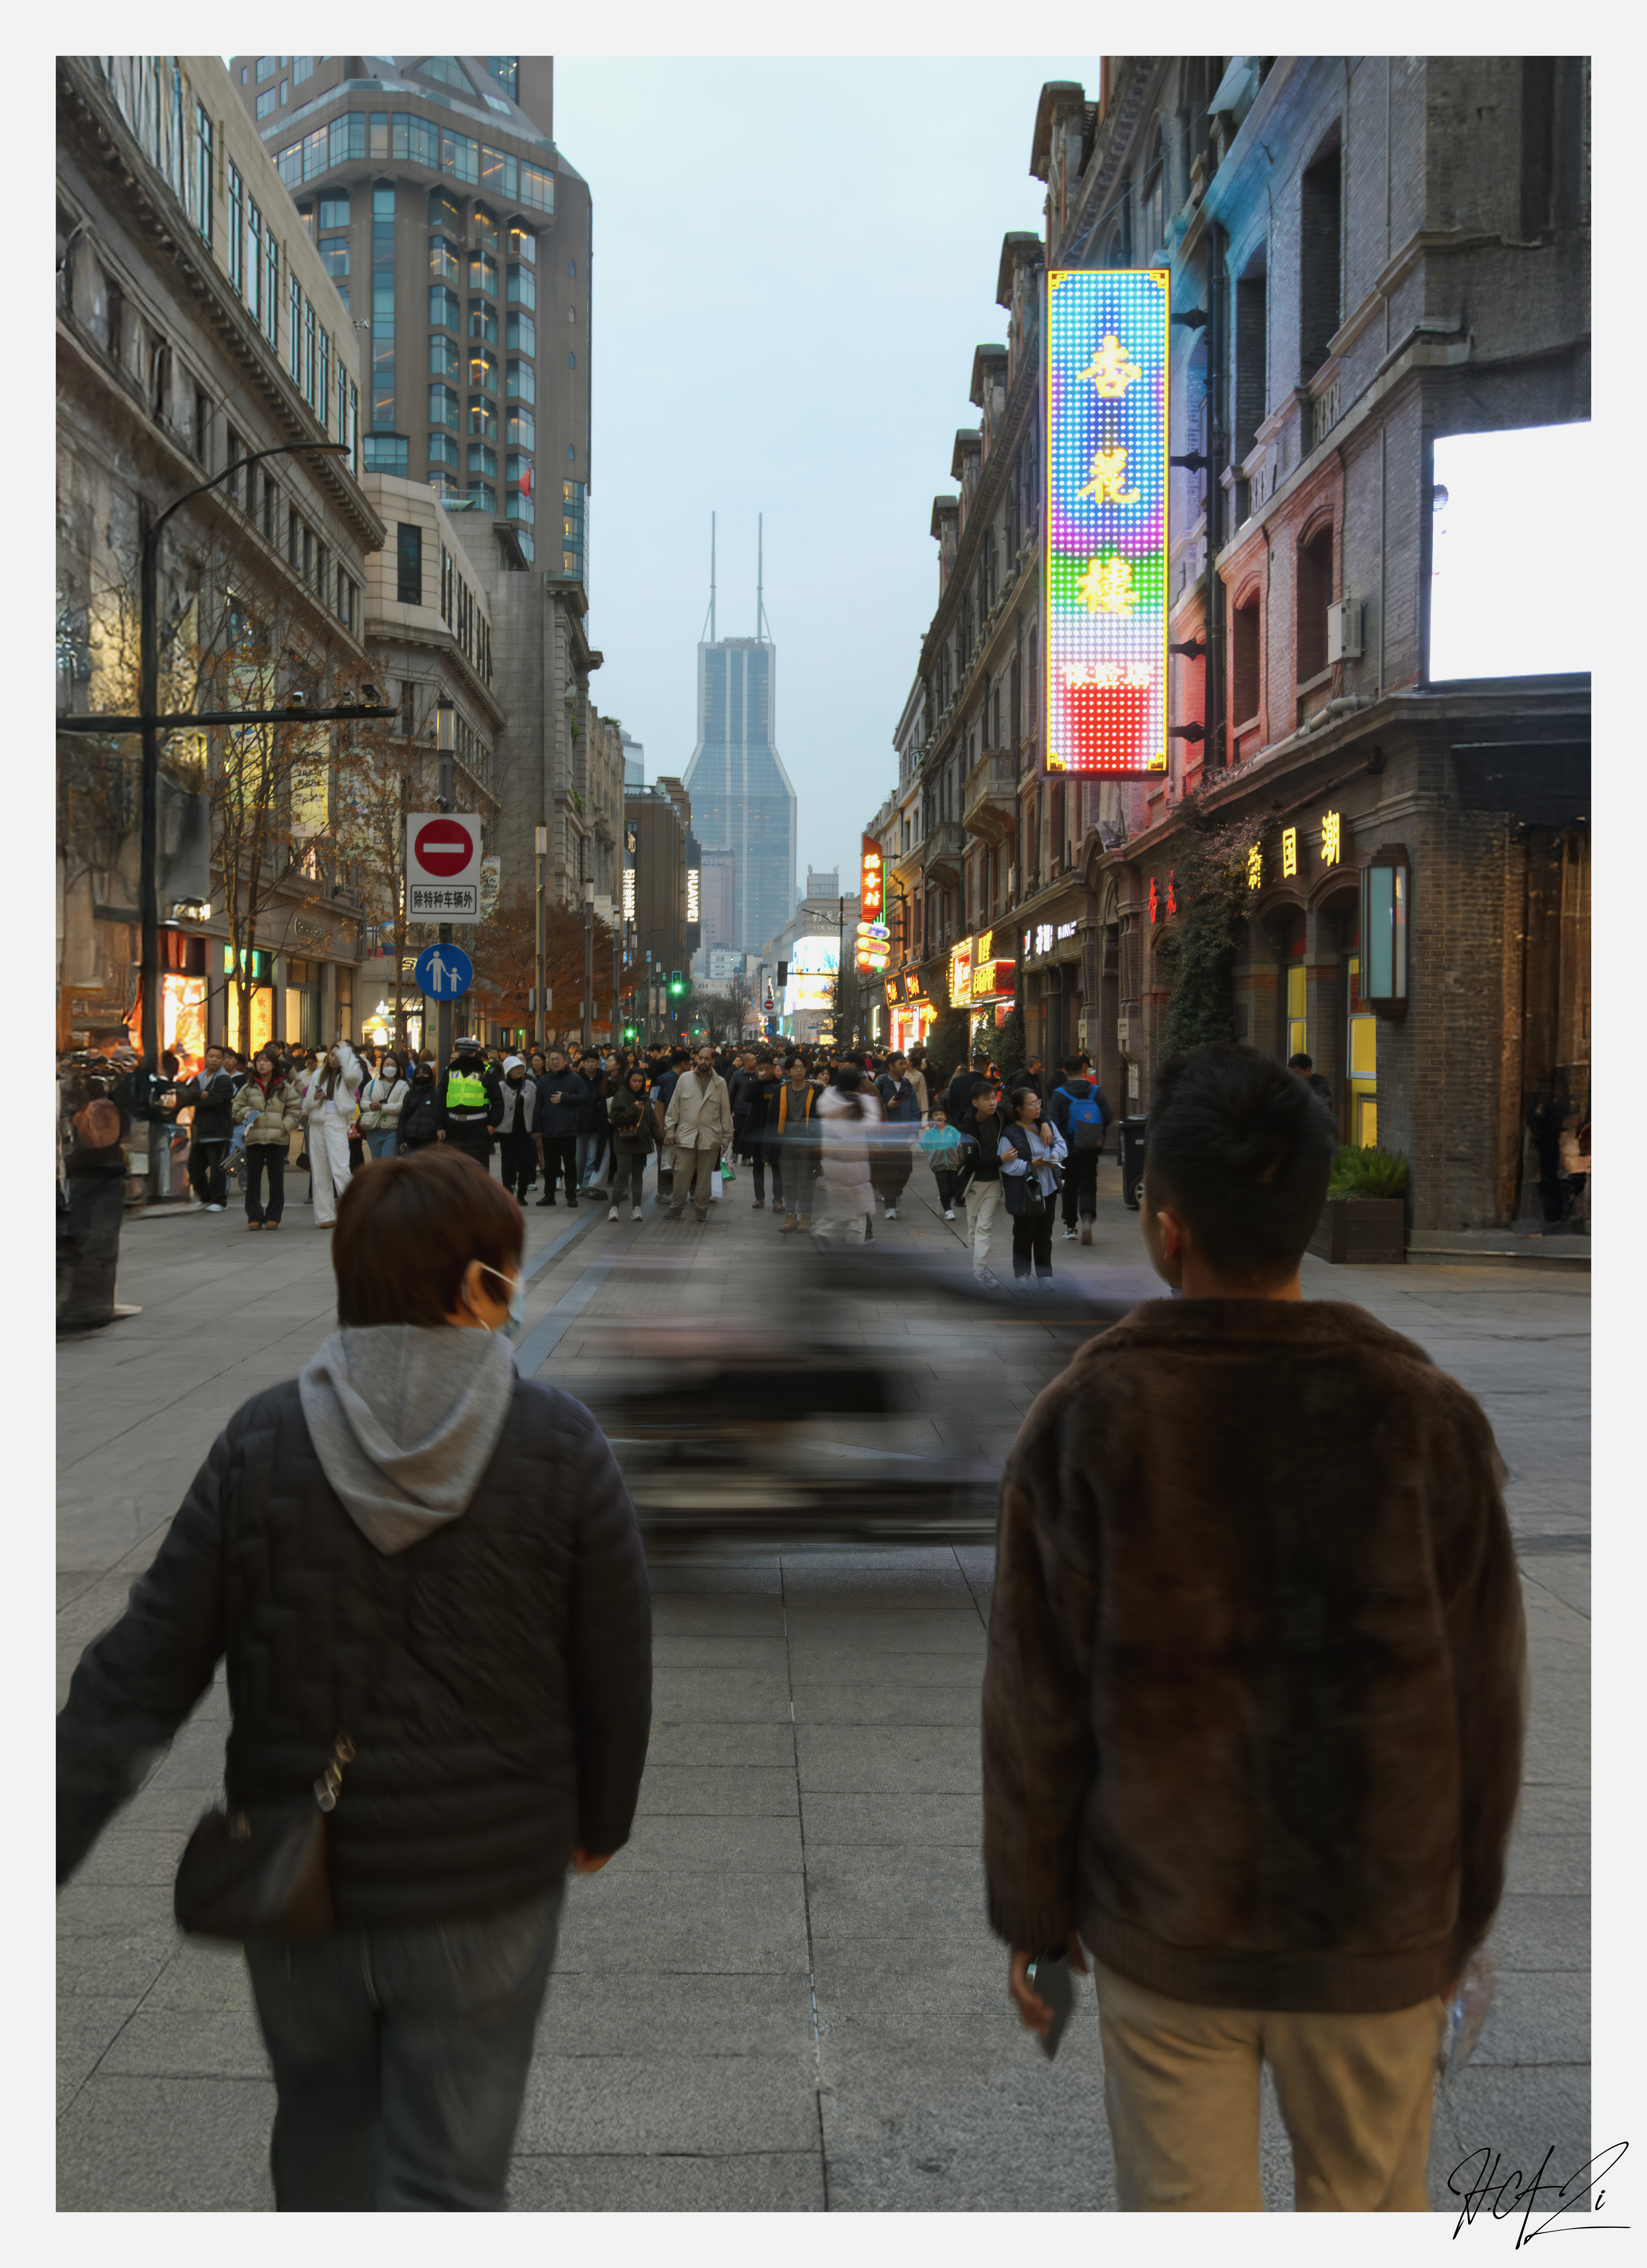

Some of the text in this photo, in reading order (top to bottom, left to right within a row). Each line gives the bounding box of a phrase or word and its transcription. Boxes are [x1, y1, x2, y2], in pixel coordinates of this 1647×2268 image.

[413, 891, 473, 909] 除特种车辆外
[687, 870, 699, 922] HUAWEI
